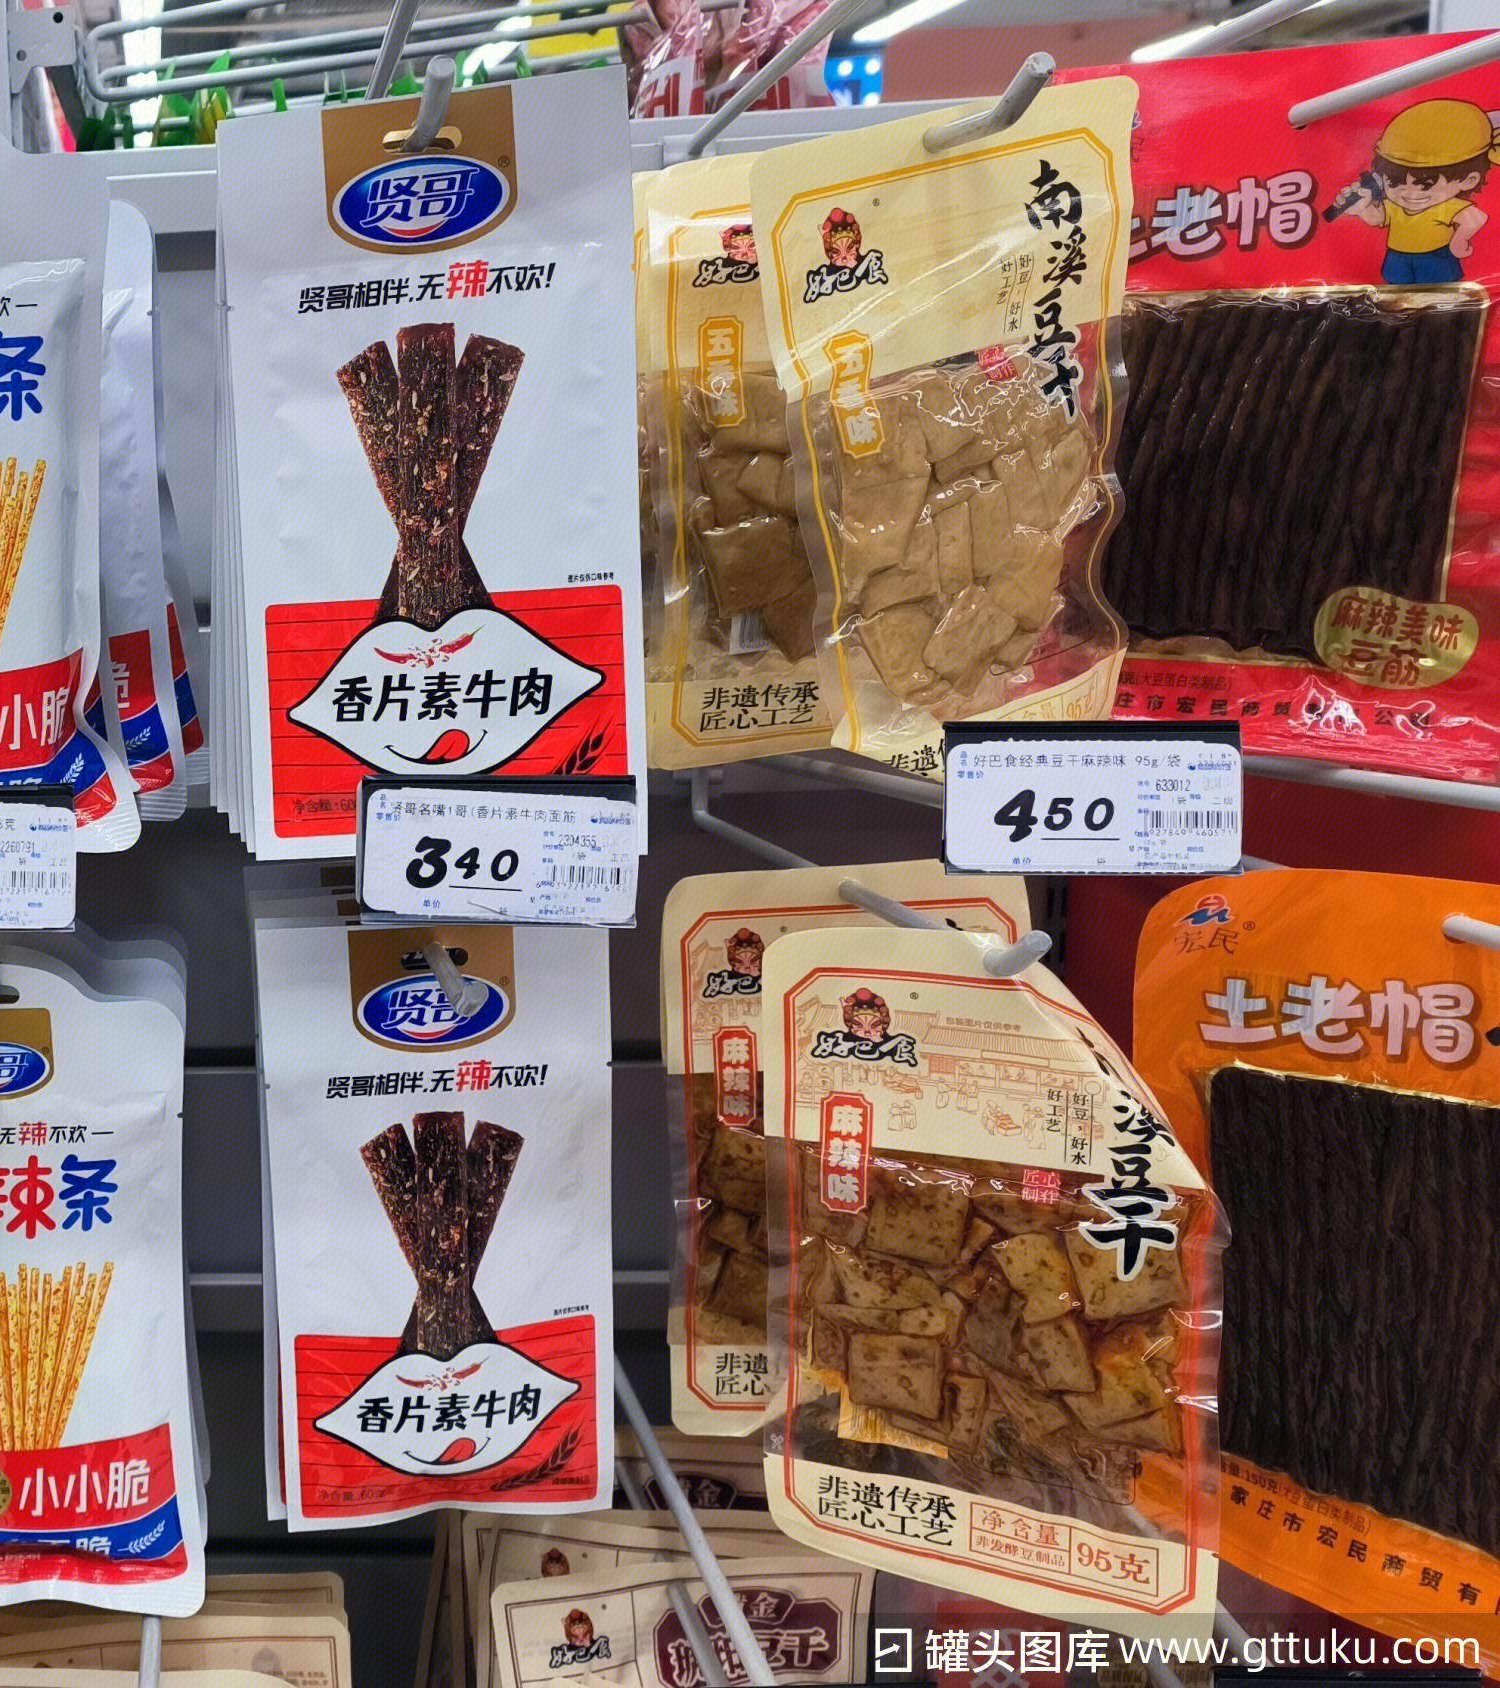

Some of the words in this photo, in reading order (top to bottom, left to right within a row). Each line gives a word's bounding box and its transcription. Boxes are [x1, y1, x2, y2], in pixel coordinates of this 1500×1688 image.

[361, 167, 481, 229] 贤哥
[693, 257, 759, 287] 好巴
[1331, 594, 1464, 651] 麻辣美味
[333, 667, 554, 722] 香片素牛肉
[702, 681, 819, 709] 非遗传承
[700, 703, 816, 732] 匠心工艺
[883, 737, 944, 777] 非遗
[1155, 779, 1191, 792] 633012
[994, 789, 1115, 843] 450
[406, 836, 519, 889] 340
[703, 971, 762, 998] 好巴
[1200, 976, 1476, 1065] 土老帽
[1047, 1088, 1063, 1132] 好工艺
[1084, 1085, 1176, 1276] 溪豆干
[715, 1352, 769, 1376] 非遗
[715, 1375, 771, 1396] 匠心
[357, 1384, 542, 1433] 香片素牛肉
[19, 1459, 150, 1517] 小小脆
[818, 1475, 956, 1520] 非遗传承
[818, 1497, 953, 1547] 匠心工艺
[981, 1510, 1061, 1547] 净含量
[975, 1536, 1066, 1567] 非发酵豆制品
[1076, 1542, 1150, 1585] 95克
[1230, 1485, 1500, 1615] 家庄市宏民商贸有
